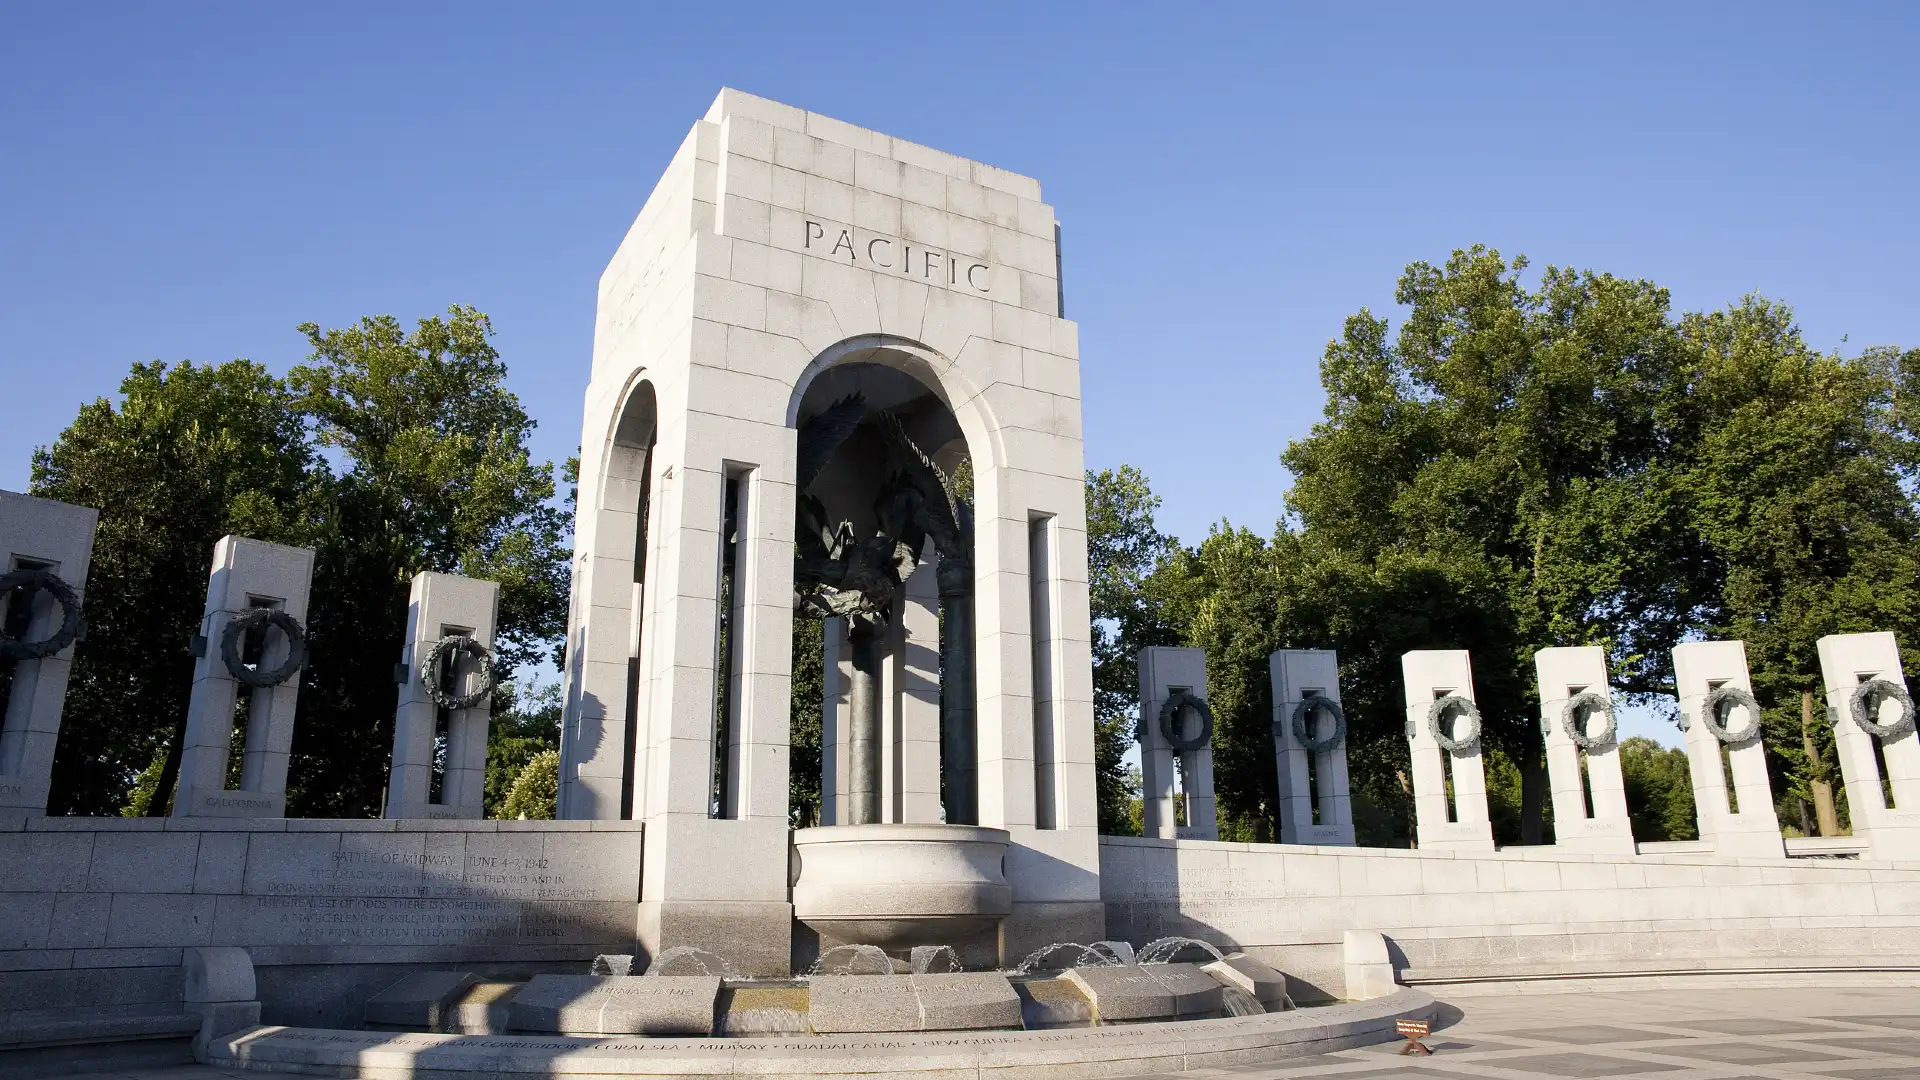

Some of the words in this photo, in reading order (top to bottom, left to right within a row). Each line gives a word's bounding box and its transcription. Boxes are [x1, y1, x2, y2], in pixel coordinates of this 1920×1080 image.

[803, 219, 991, 294] PACIFIC
[206, 797, 272, 809] CALIFORNIA
[1313, 830, 1340, 838] MAINE
[331, 851, 377, 863] BATTLE
[381, 853, 399, 864] OF
[402, 854, 456, 866] MIDWAY
[469, 856, 498, 868] JUNE
[525, 859, 549, 869] 1942
[464, 874, 481, 883] YET
[484, 874, 508, 884] THEY
[532, 876, 552, 885] AND
[555, 876, 565, 885] IN
[268, 883, 306, 893] DOING
[308, 883, 324, 893] SO
[356, 885, 409, 895] CHANGED
[491, 888, 499, 897] A
[557, 889, 596, 899] AGAINST
[339, 899, 355, 909] OF
[394, 900, 427, 910] THERE
[429, 901, 438, 910] IS
[441, 900, 501, 911] SOMETHING
[653, 986, 695, 997] INDIA
[480, 1040, 580, 1051] CORREGIDOR
[594, 1043, 648, 1051] CORAL
[650, 1043, 680, 1051] SEA
[699, 1043, 768, 1051] MIDWAY
[785, 1041, 906, 1051] GUADALCANAL
